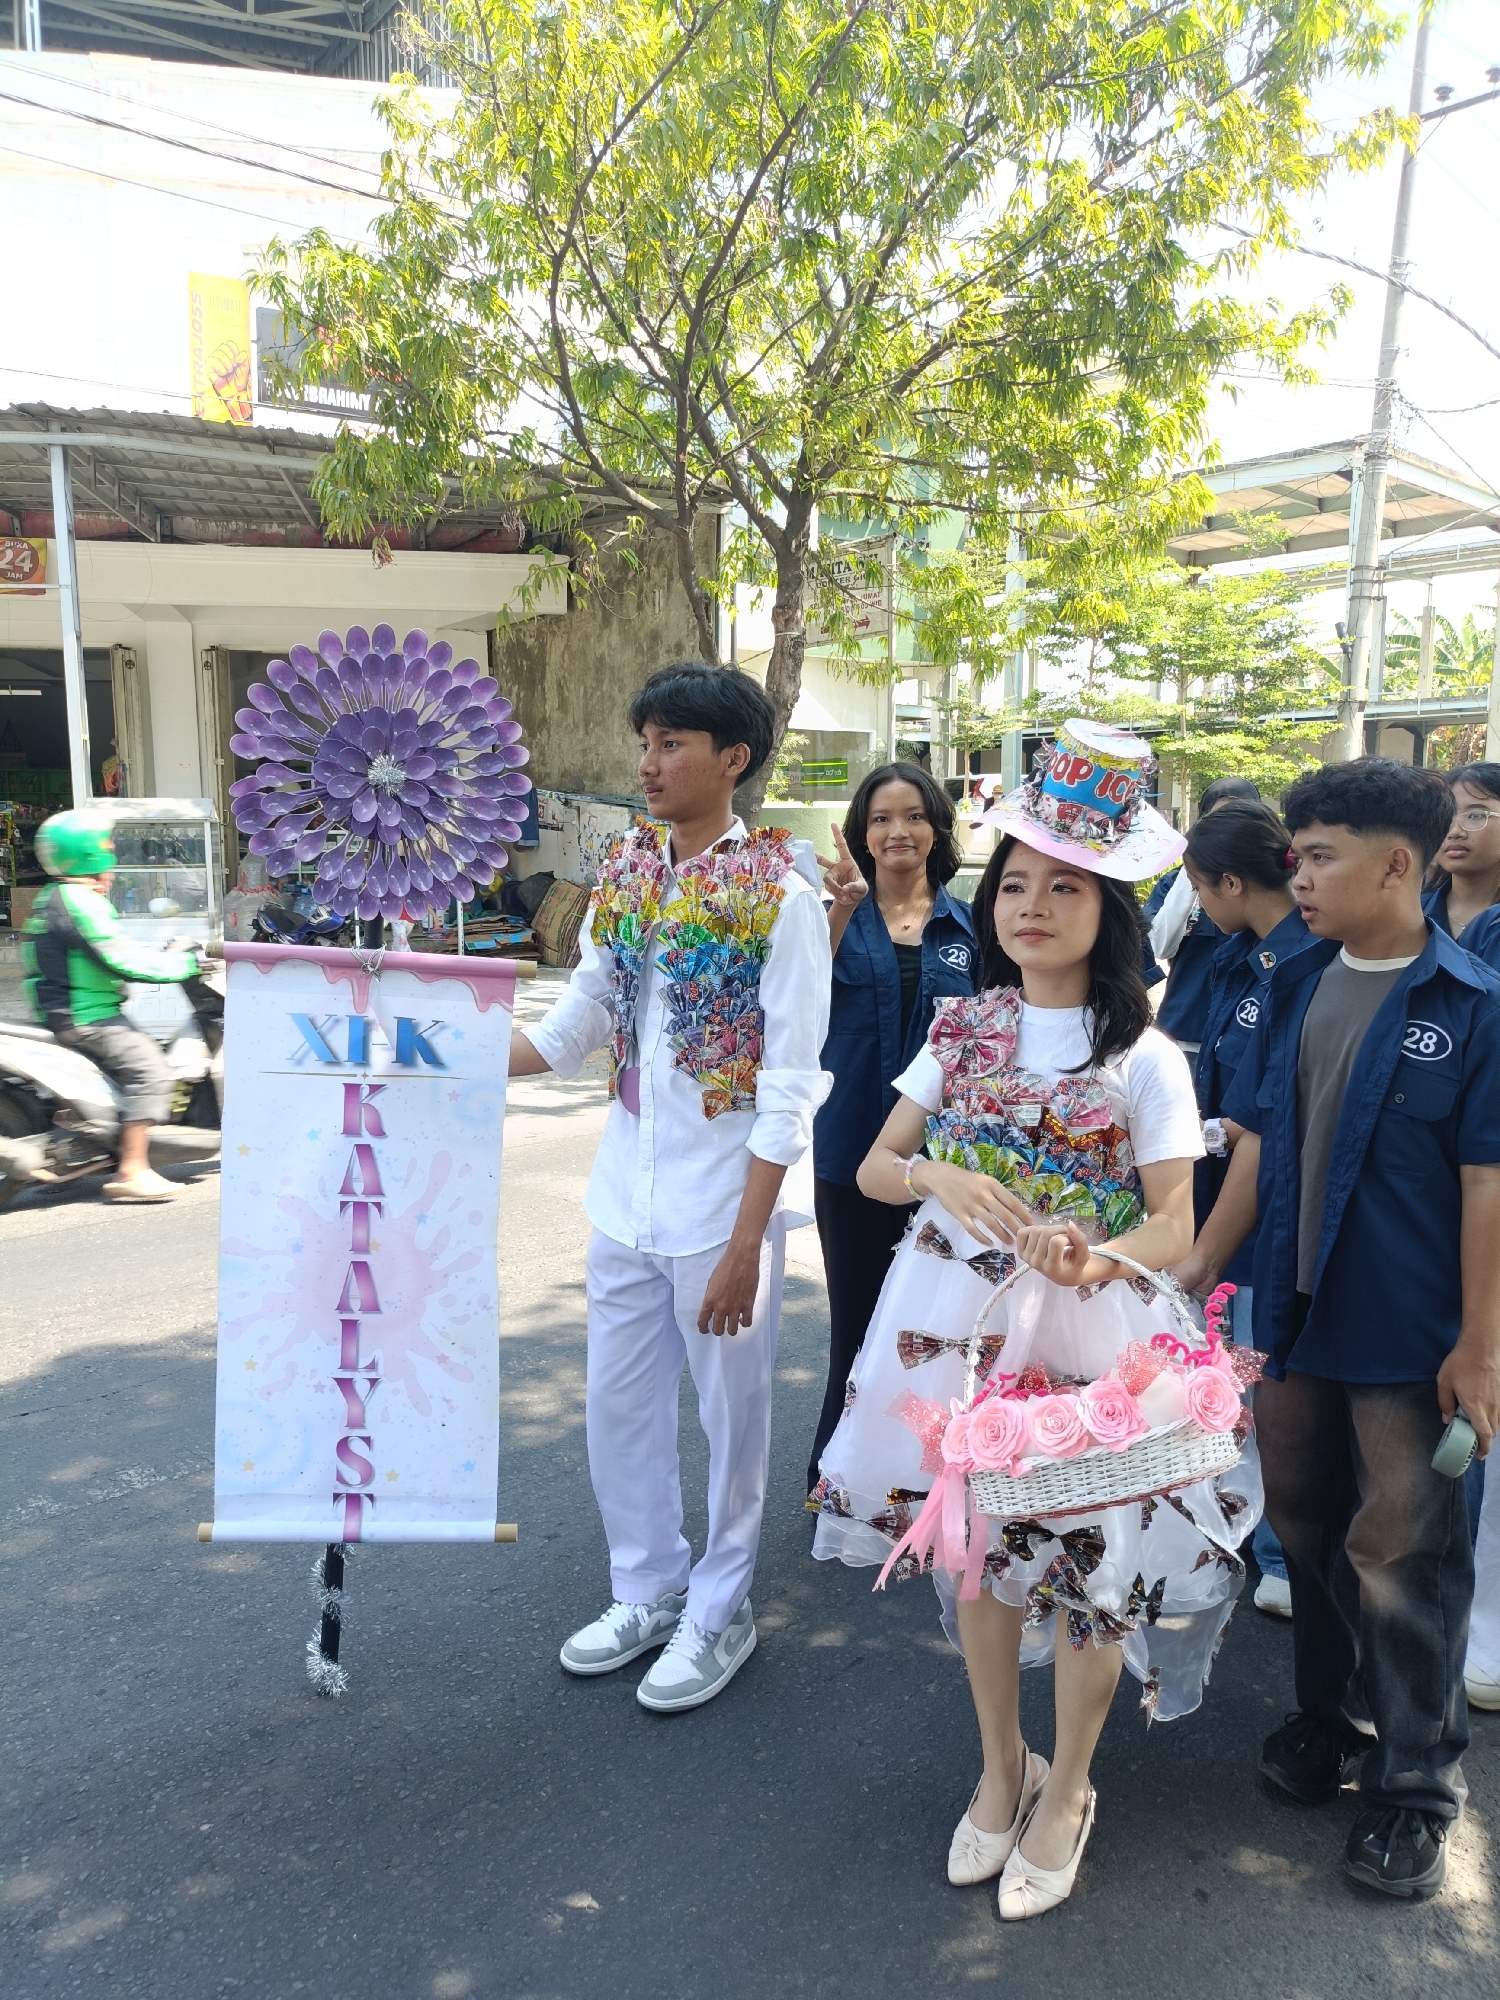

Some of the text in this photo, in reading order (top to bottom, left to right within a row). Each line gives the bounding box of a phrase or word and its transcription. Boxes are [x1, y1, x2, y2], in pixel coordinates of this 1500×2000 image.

[5, 540, 29, 550] BUKA
[0, 547, 33, 573] 24
[5, 571, 23, 580] JAM
[947, 948, 967, 966] 28
[1240, 1002, 1259, 1022] 28
[285, 1012, 445, 1066] XI-K
[1403, 1027, 1438, 1054] 28
[332, 1082, 387, 1543] KATALYST
